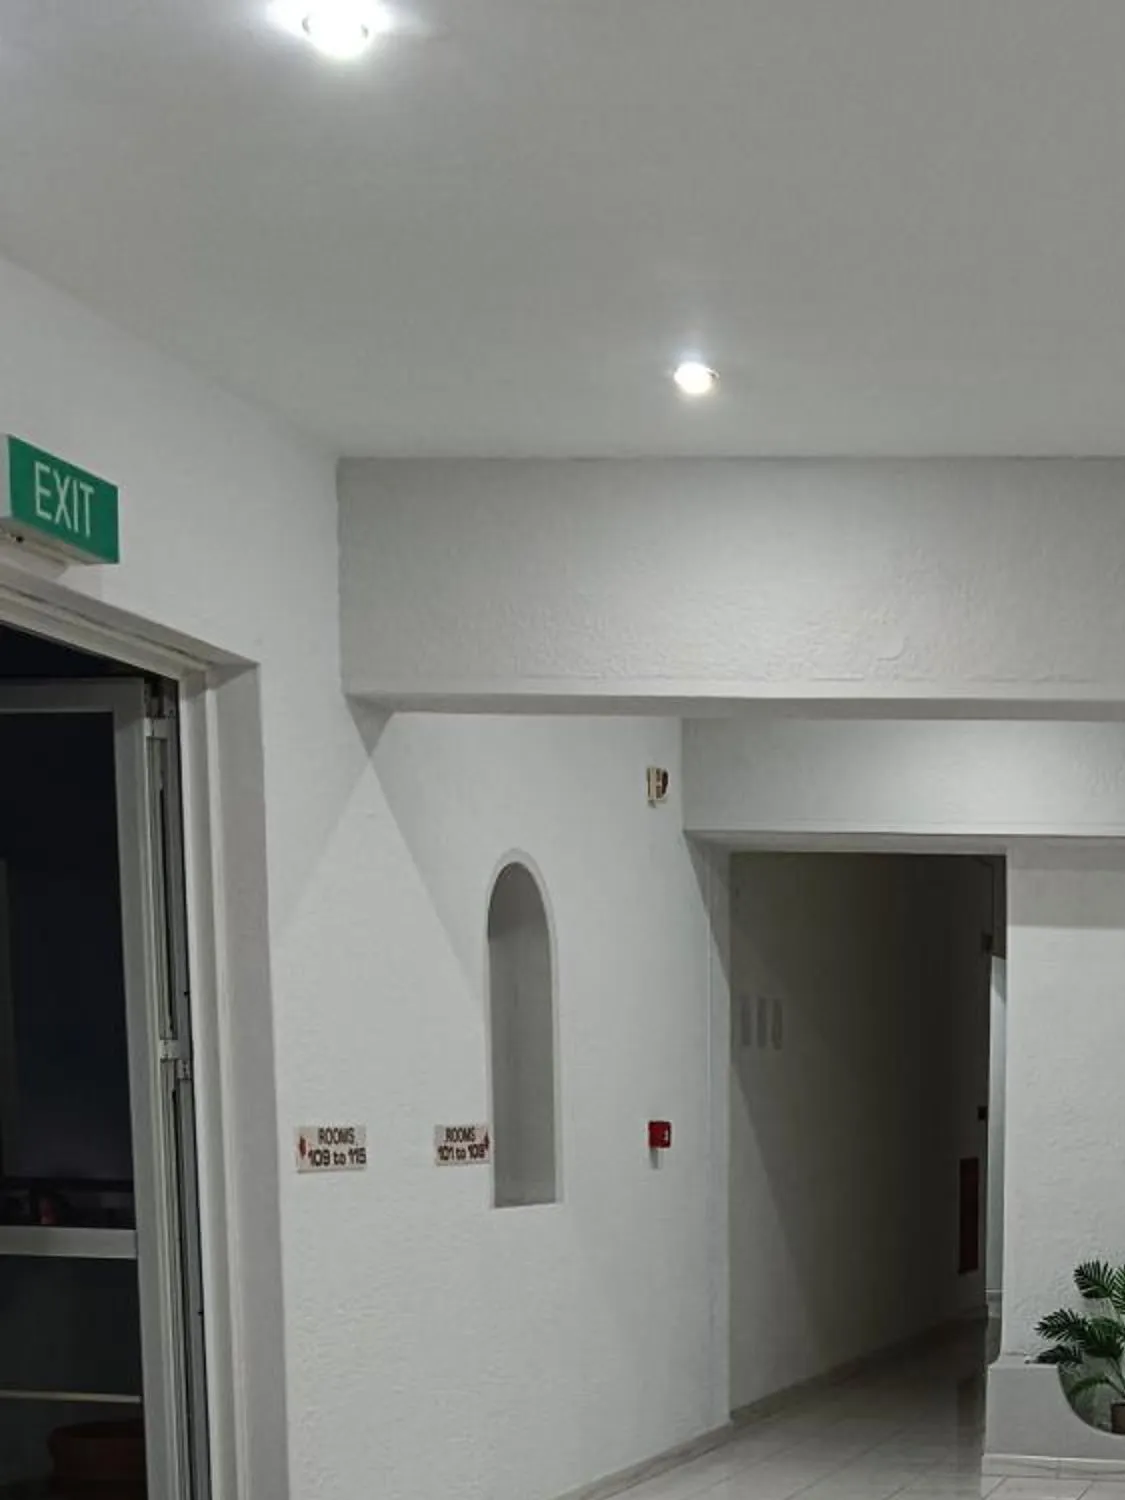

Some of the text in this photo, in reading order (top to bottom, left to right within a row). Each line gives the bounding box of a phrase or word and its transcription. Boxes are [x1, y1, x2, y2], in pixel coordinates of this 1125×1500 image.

[34, 460, 95, 538] EXIT
[318, 1127, 356, 1145] ROOMS
[446, 1127, 476, 1143] ROOMS
[308, 1148, 331, 1166] 109
[333, 1151, 346, 1165] to
[456, 1148, 466, 1160] to
